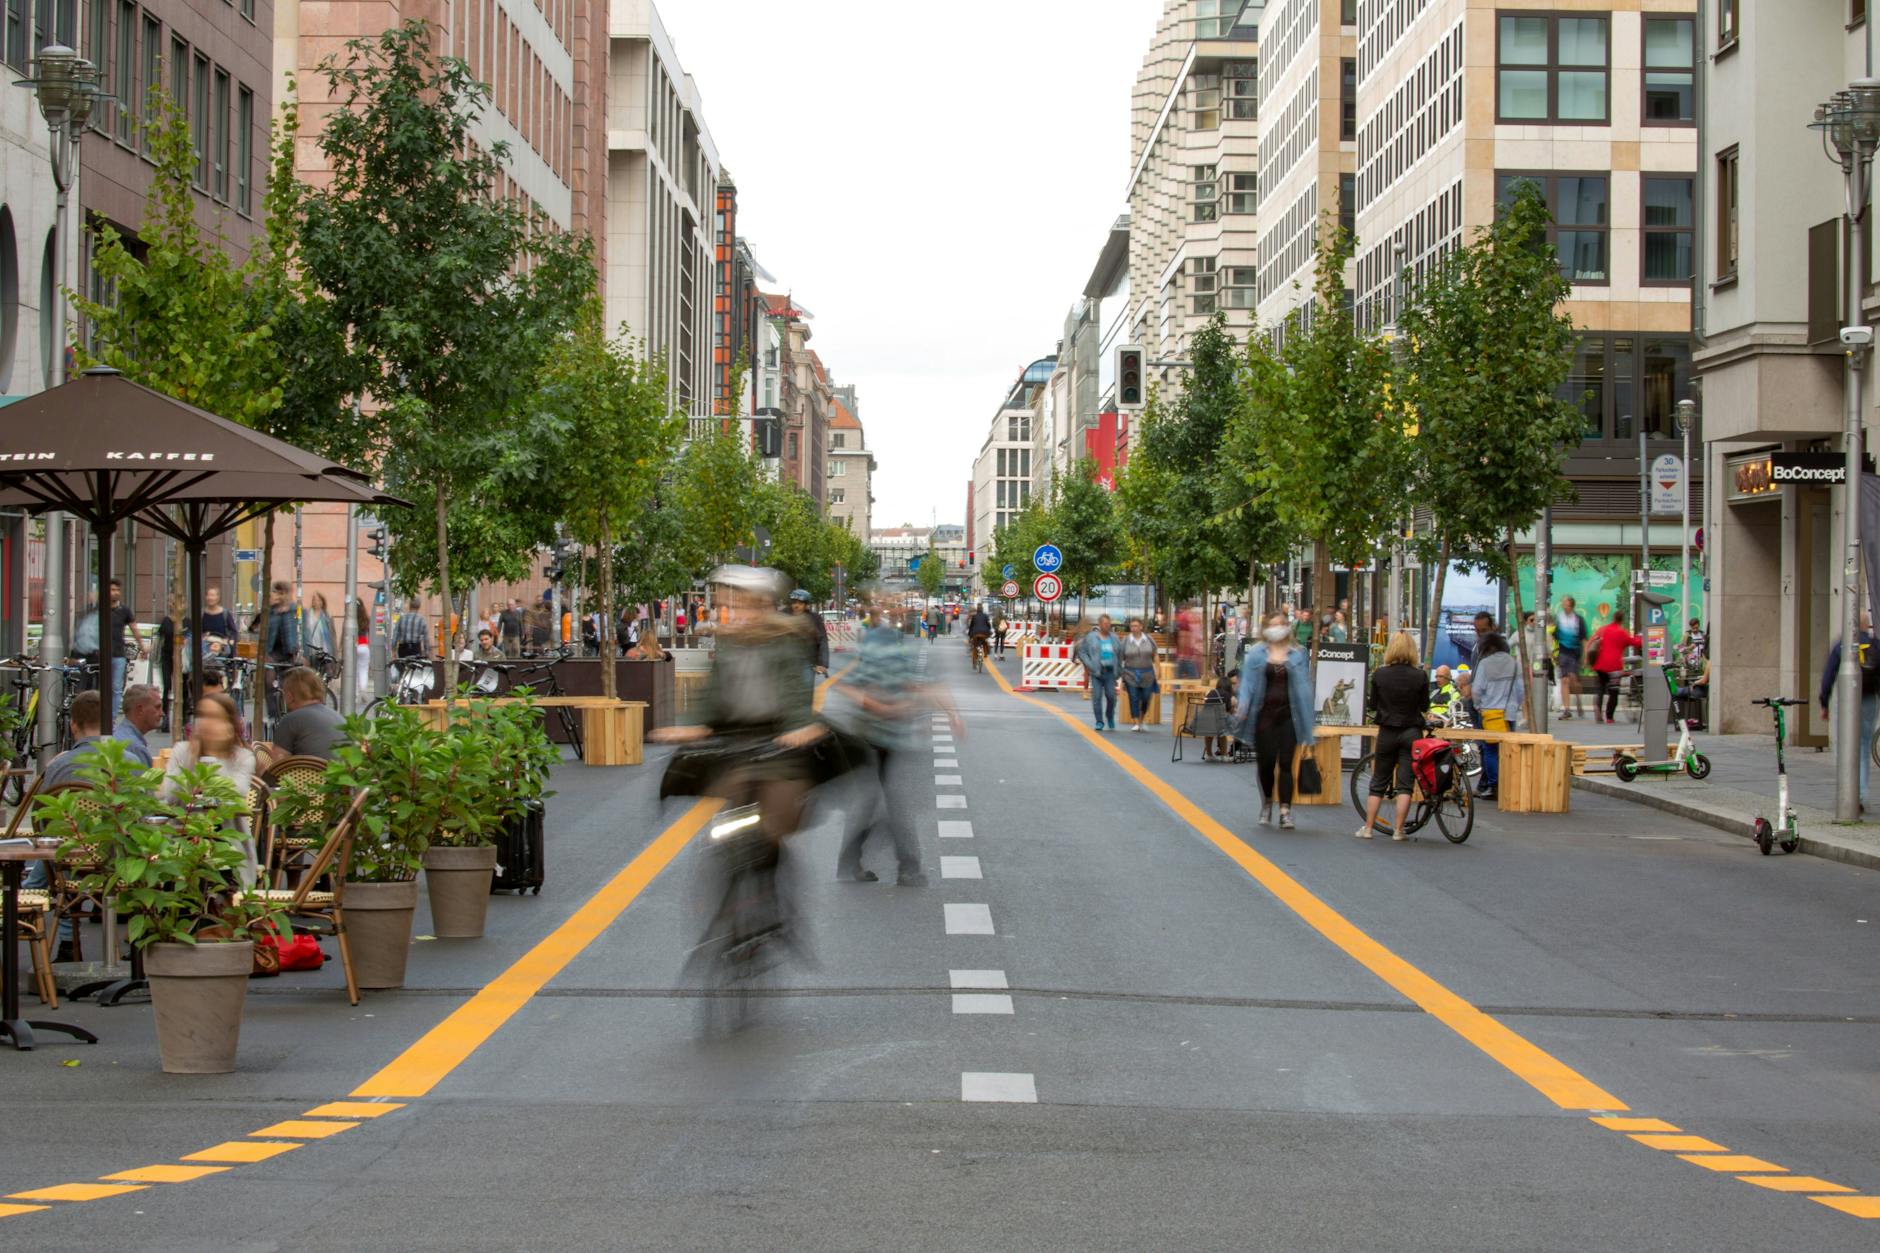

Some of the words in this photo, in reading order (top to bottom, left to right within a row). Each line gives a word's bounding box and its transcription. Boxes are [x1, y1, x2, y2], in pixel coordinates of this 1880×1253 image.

[106, 452, 215, 461] KAFFEE
[1664, 457, 1674, 465] 30
[1774, 466, 1846, 483] BoConcept
[1006, 585, 1015, 593] 20
[1041, 582, 1055, 593] 20
[1652, 608, 1662, 624] P
[1309, 649, 1355, 661] Concept
